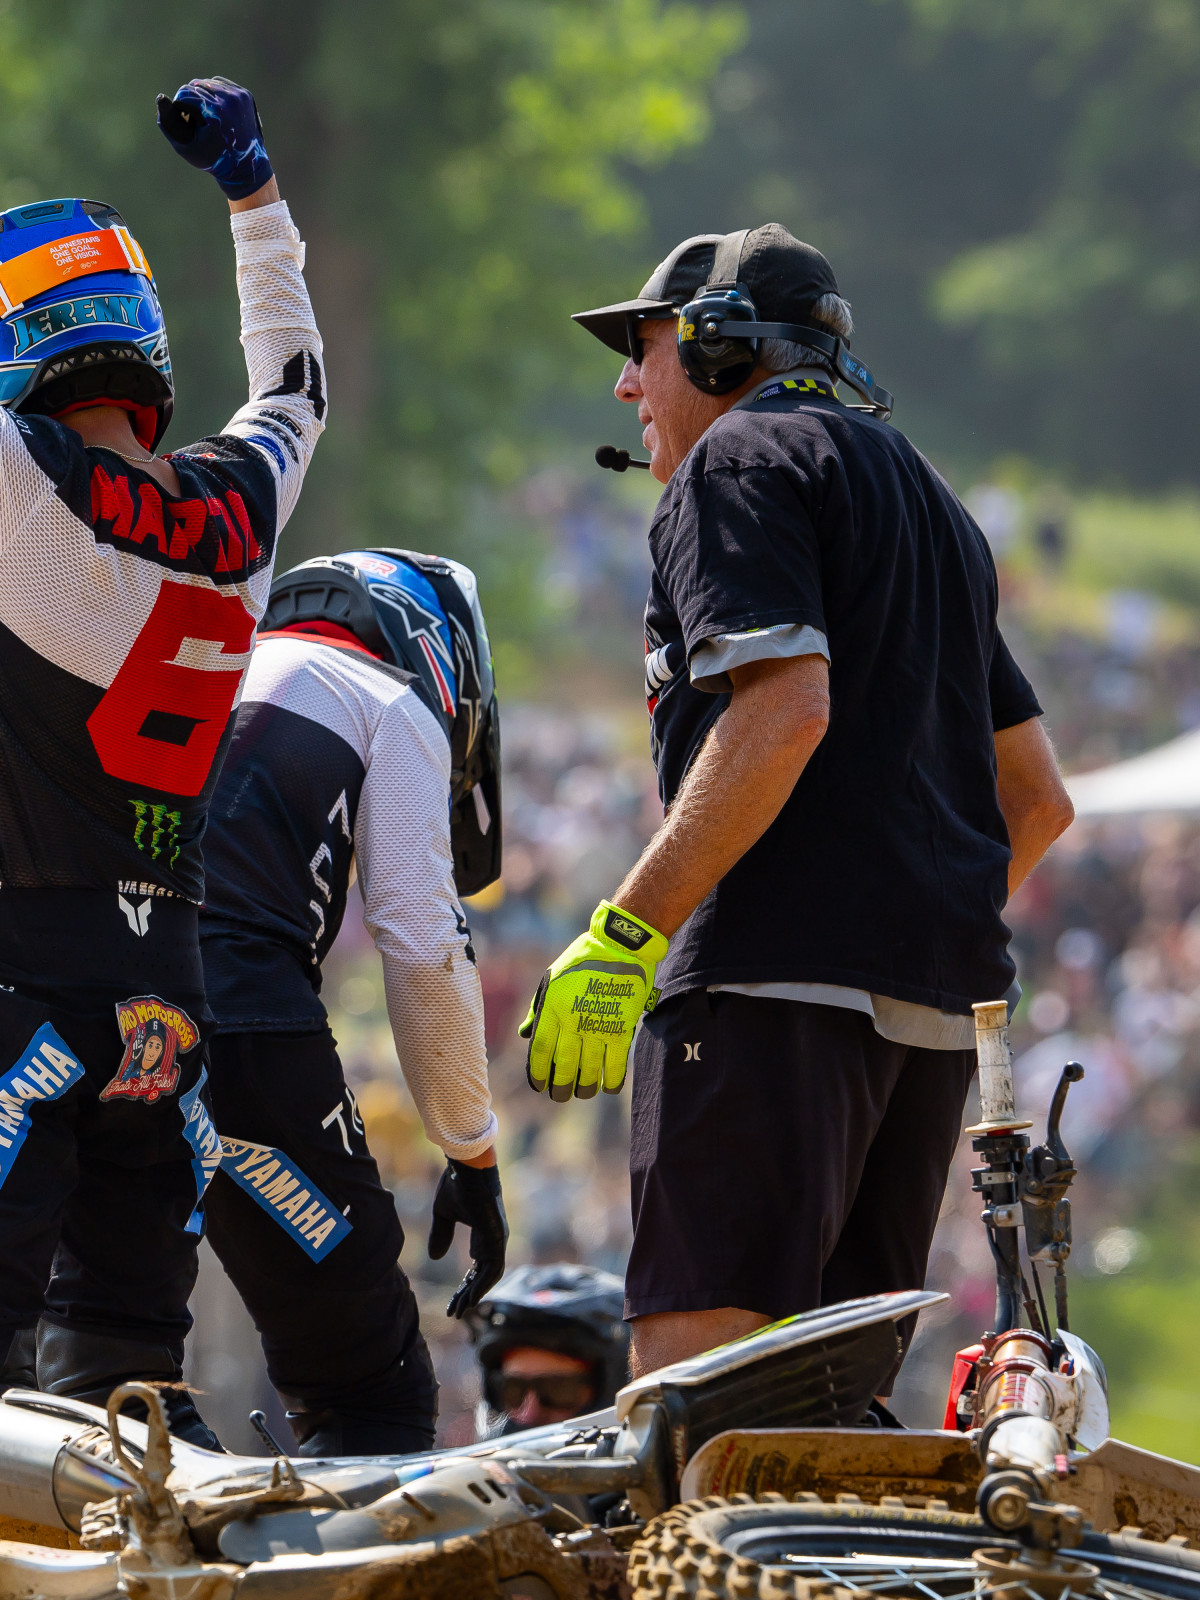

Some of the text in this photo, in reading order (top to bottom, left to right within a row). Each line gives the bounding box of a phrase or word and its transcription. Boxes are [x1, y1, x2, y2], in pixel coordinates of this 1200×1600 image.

[50, 236, 101, 254] ALPINESTARS
[52, 249, 71, 260] ONE
[56, 249, 102, 266] ONE VISION.
[8, 295, 144, 357] JEREMY
[86, 579, 257, 797] 6
[120, 1003, 194, 1047] PRO MOTOCROSS
[153, 1021, 158, 1030] 6
[235, 1148, 337, 1249] YAMAHA
